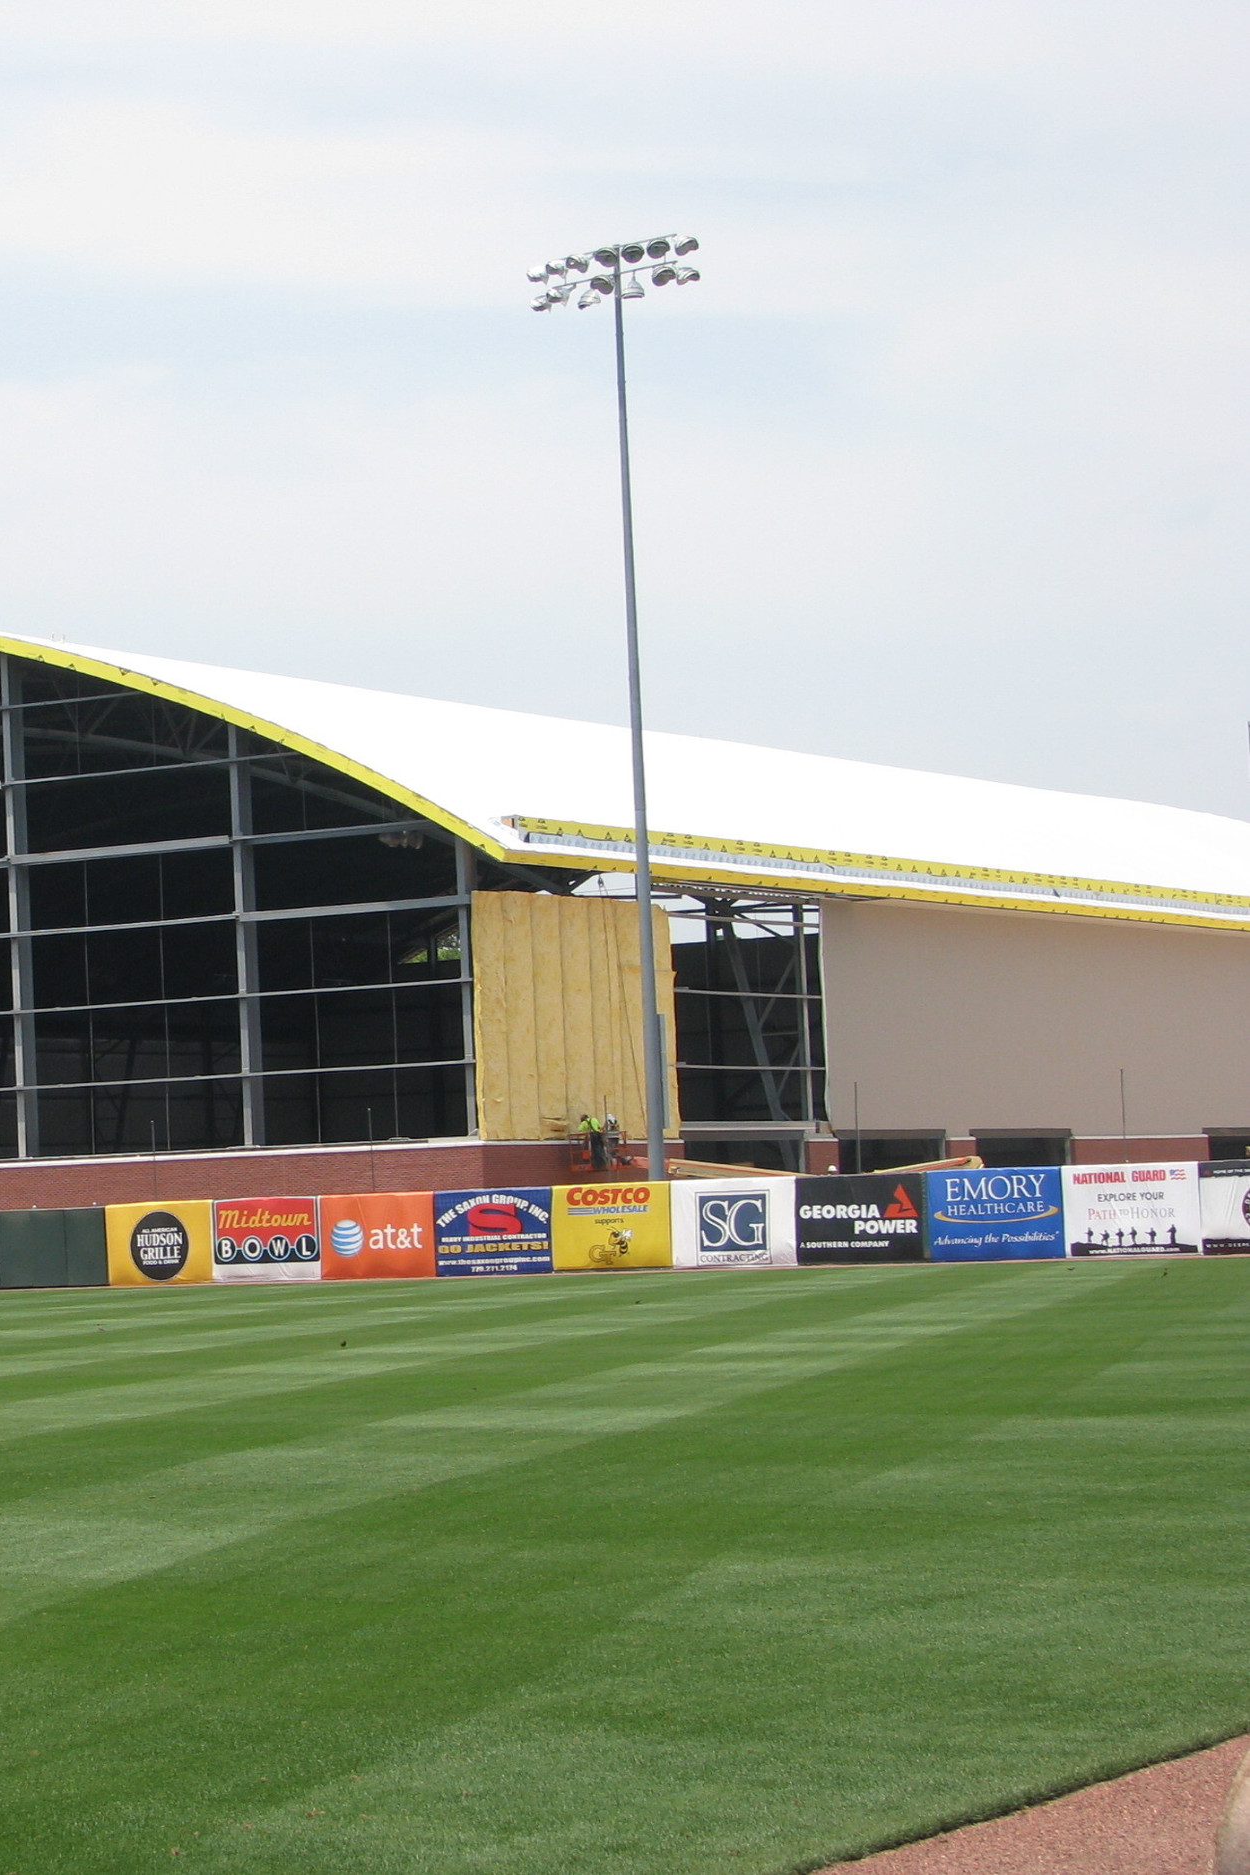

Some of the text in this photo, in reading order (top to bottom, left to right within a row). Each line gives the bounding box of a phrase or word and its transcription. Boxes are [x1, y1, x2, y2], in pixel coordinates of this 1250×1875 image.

[1073, 1169, 1166, 1185] NATIONAL GUARD
[945, 1173, 1046, 1202] EMORY
[566, 1187, 650, 1206] COSTCO
[1097, 1191, 1165, 1202] EXPLORE YOUR
[436, 1208, 458, 1228] THE
[454, 1194, 490, 1215] SAXON
[528, 1204, 550, 1224] INC.
[591, 1205, 648, 1214] WHOLESALE
[799, 1204, 881, 1219] GEORGIA
[947, 1201, 1045, 1216] HEALTHCARE
[1130, 1206, 1176, 1219] HONOR
[218, 1208, 312, 1230] Midtown
[701, 1199, 765, 1247] SG
[854, 1219, 918, 1235] POWER
[136, 1232, 183, 1247] HUDSON
[369, 1222, 423, 1250] at&t
[462, 1234, 502, 1242] INDUSTRIAL
[933, 1235, 983, 1248] Advancing
[984, 1233, 999, 1243] the
[221, 1236, 312, 1259] BOWL
[438, 1241, 549, 1254] GO JACKETS!
[850, 1240, 890, 1248] COMPANY
[140, 1246, 182, 1260] GRILLE
[700, 1253, 769, 1263] CONTRACTING
